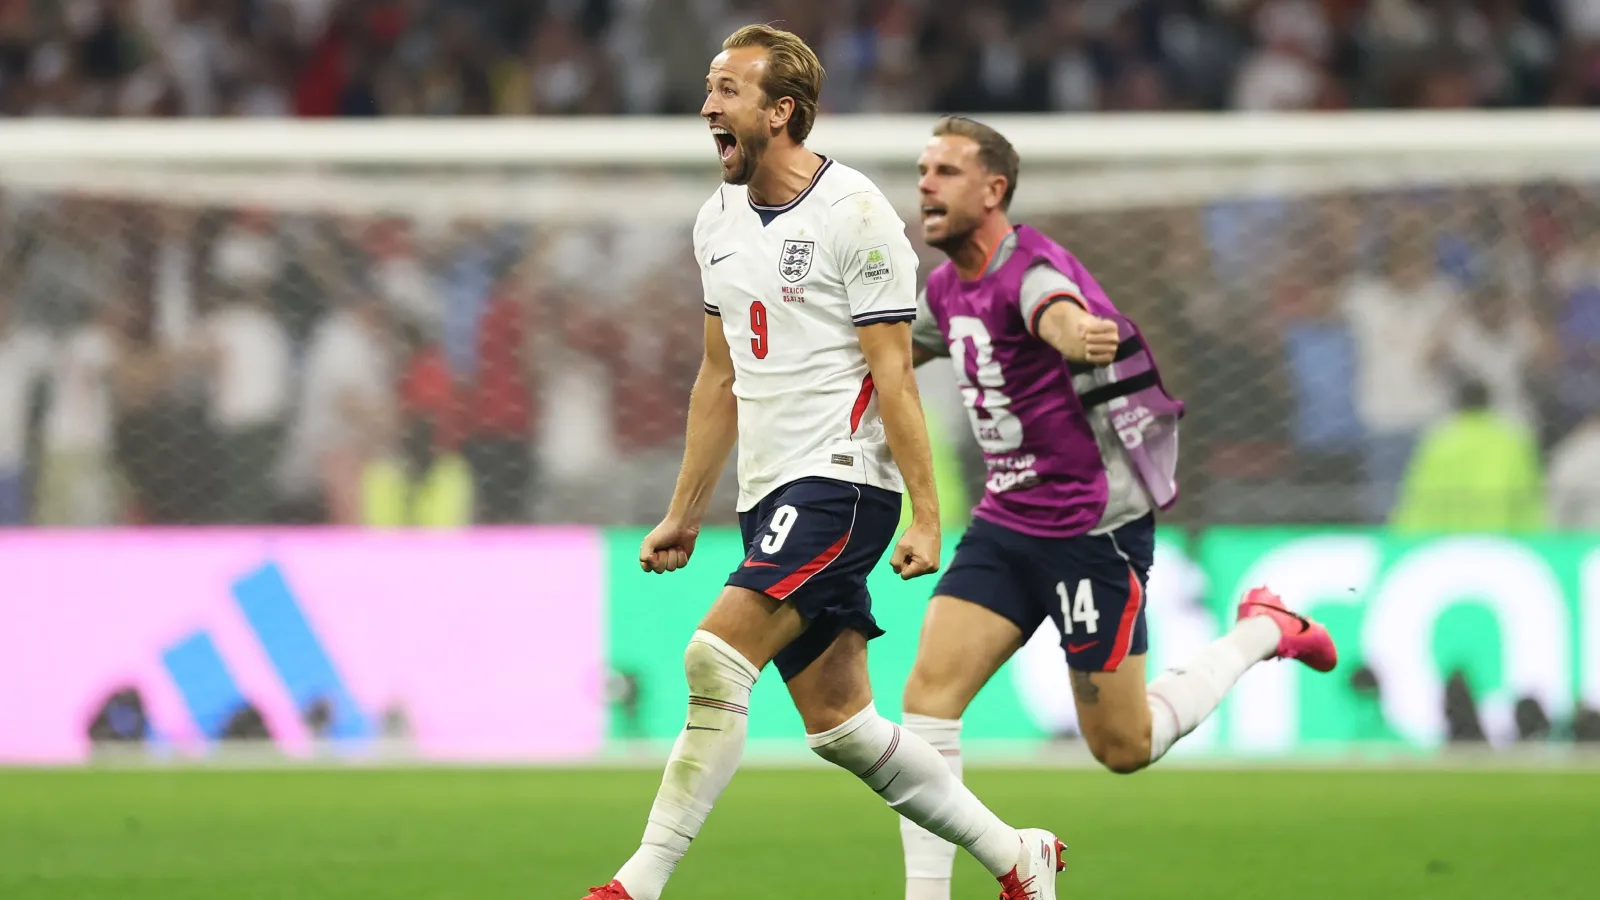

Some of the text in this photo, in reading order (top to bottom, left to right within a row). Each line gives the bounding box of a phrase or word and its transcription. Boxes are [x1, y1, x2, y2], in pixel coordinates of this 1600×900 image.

[781, 286, 805, 295] MEXICO
[864, 268, 890, 279] EDUCATION
[750, 301, 768, 359] 9
[760, 504, 799, 555] 9
[1055, 578, 1101, 635] 14
